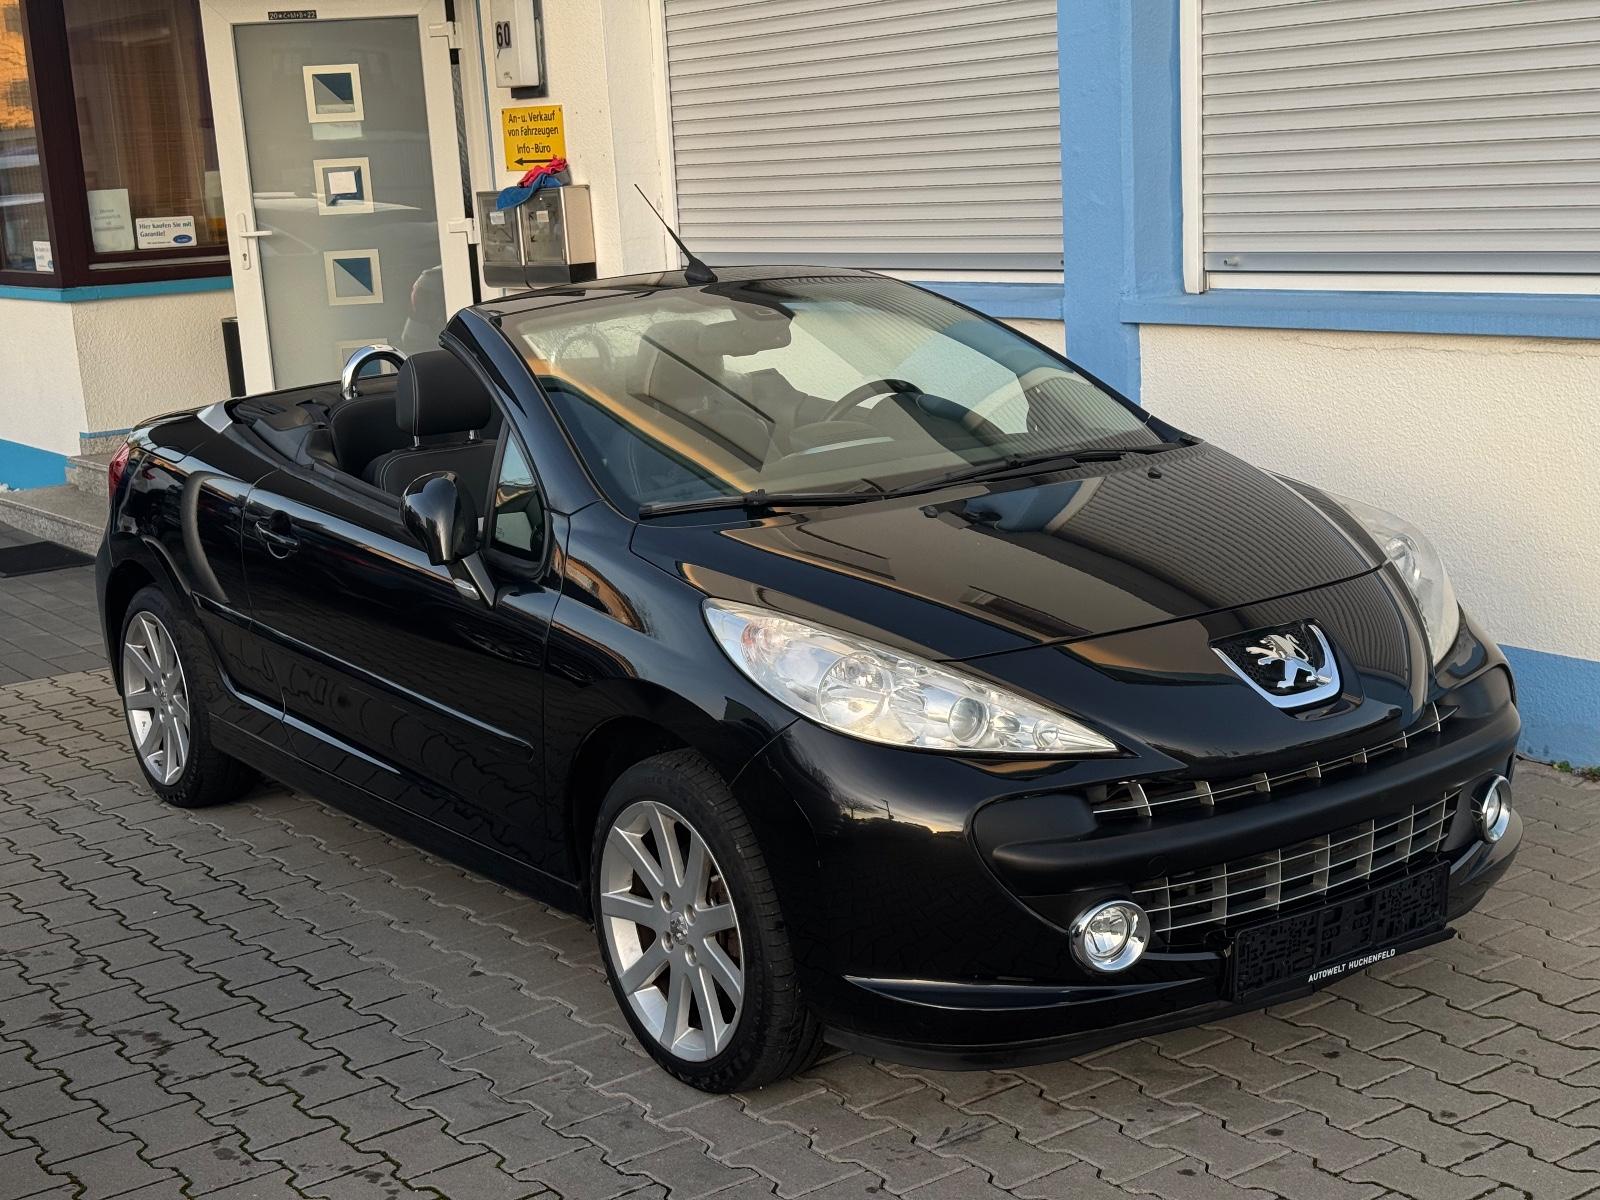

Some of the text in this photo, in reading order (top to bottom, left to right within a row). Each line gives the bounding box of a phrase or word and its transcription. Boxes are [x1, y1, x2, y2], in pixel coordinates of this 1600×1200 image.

[496, 23, 511, 47] 60
[528, 110, 555, 122] Verkauf
[508, 125, 559, 138] von Fahrzeugen
[1307, 948, 1397, 983] AUTOWELT HUCHENFELD
